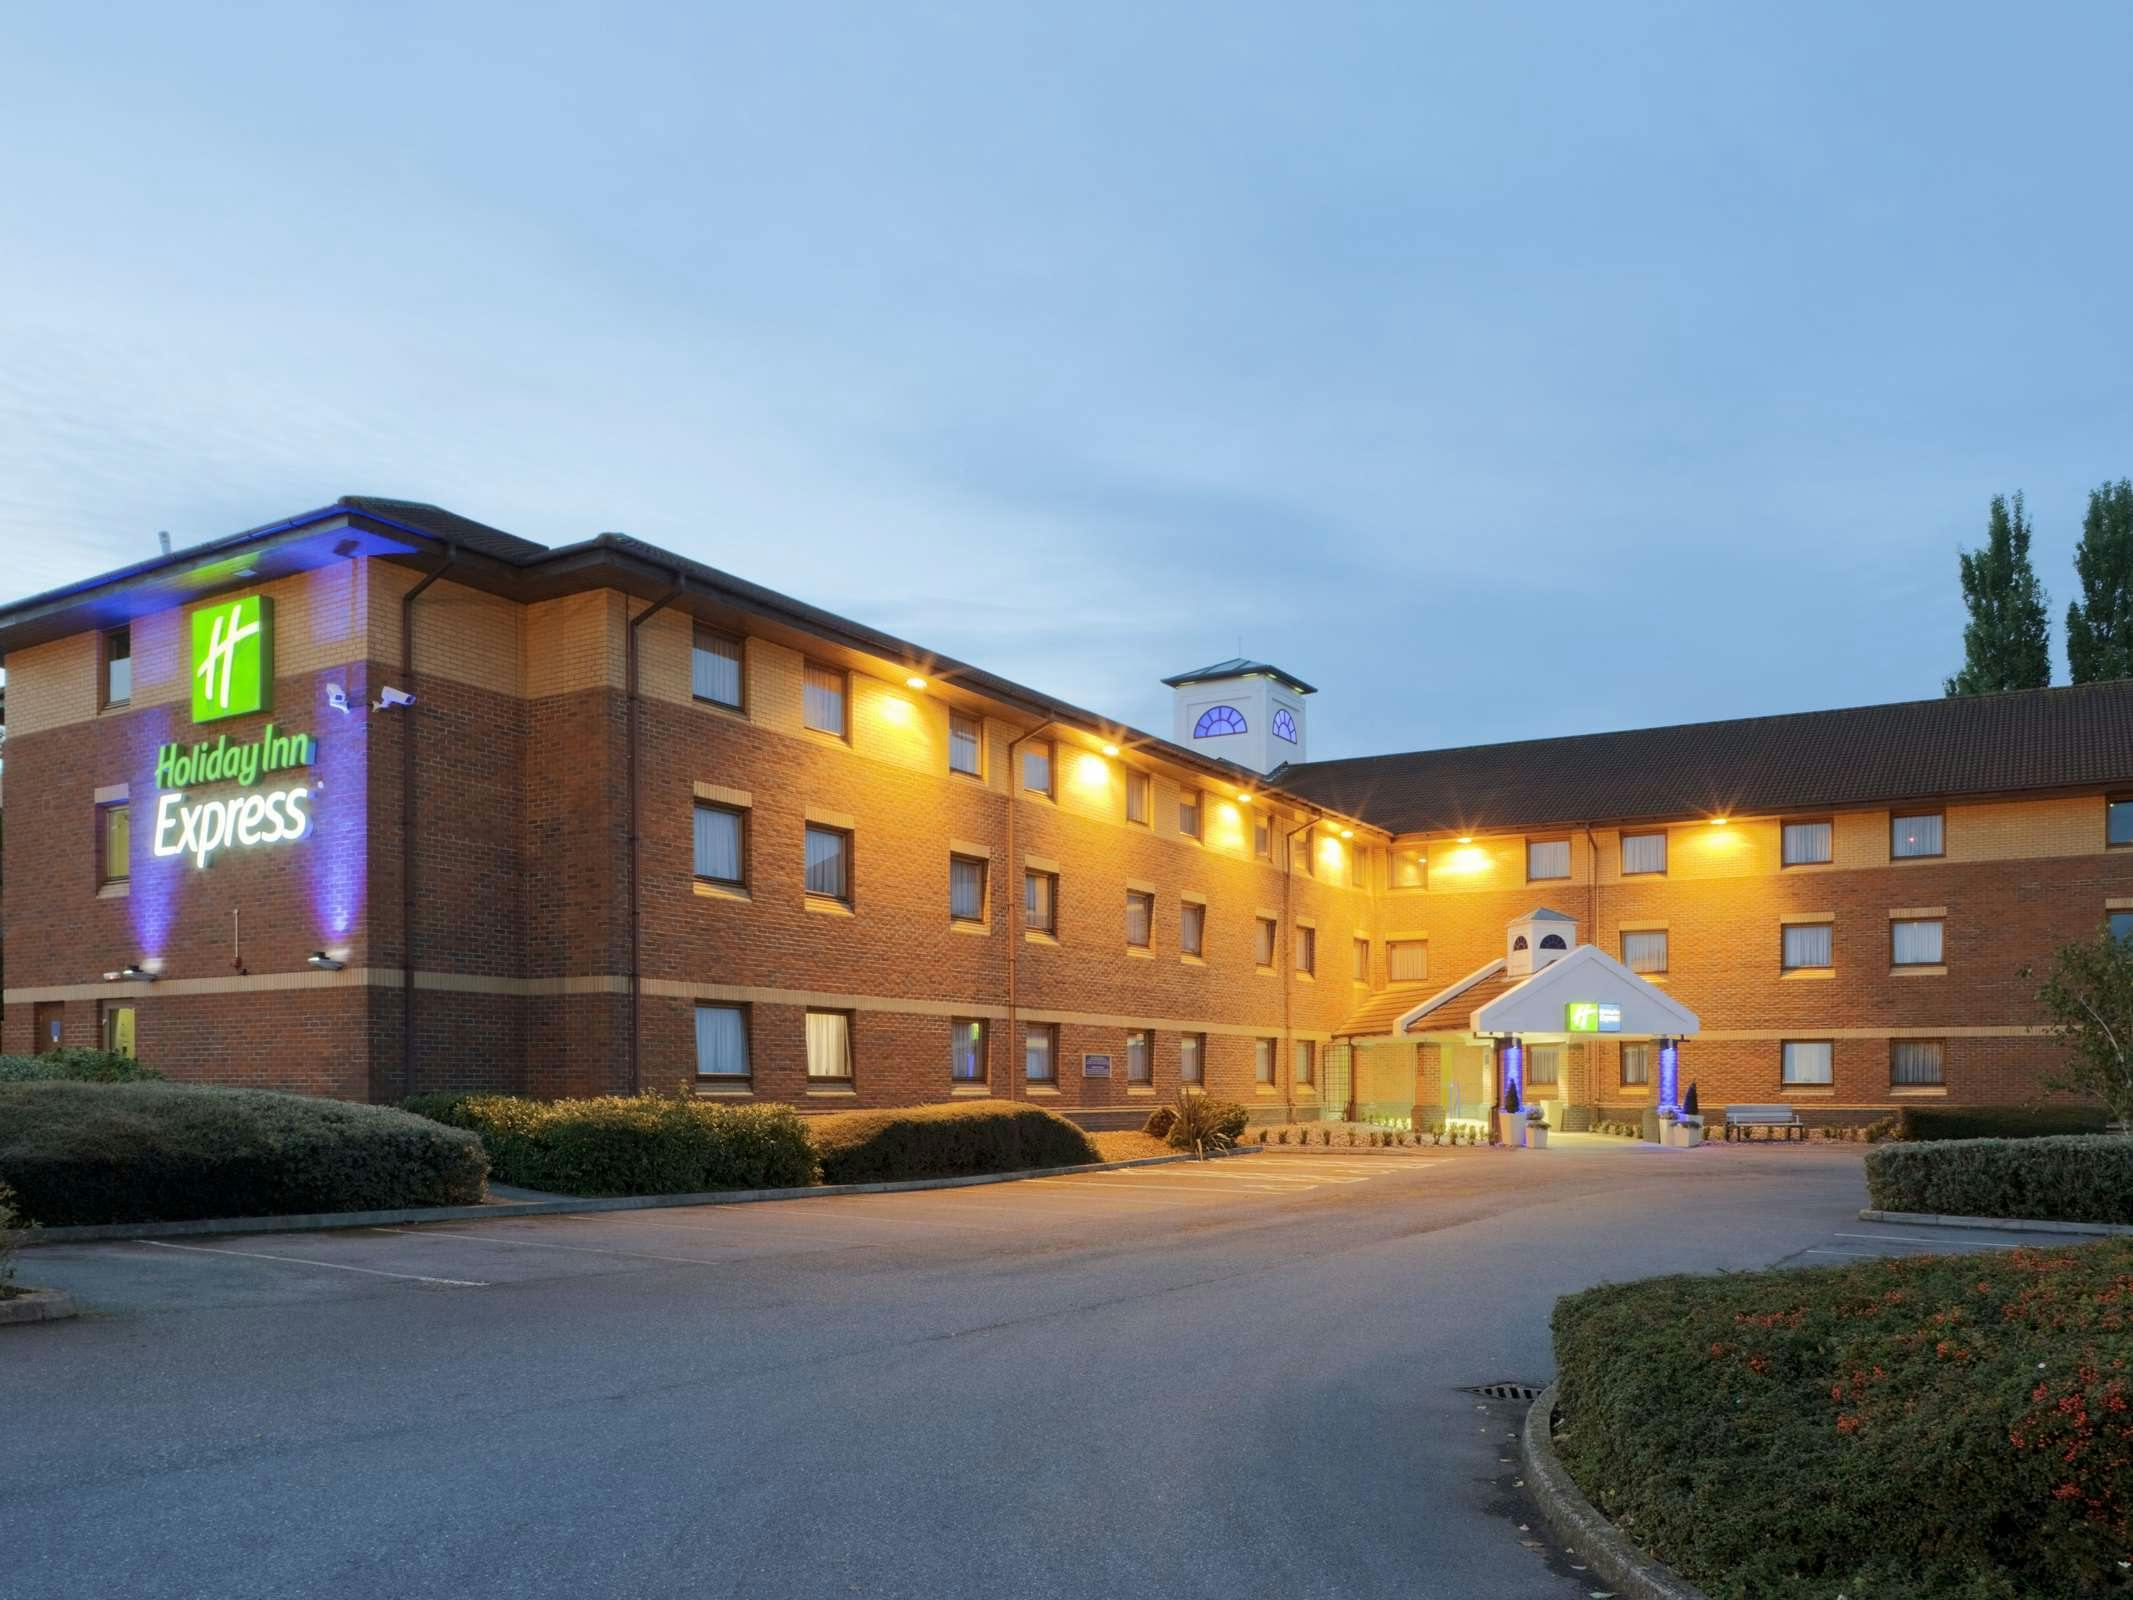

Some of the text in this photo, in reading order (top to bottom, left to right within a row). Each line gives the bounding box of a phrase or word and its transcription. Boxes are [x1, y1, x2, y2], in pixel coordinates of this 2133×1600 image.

[197, 605, 260, 709] H
[155, 724, 309, 789] Holiday Inn
[154, 788, 308, 869] Express
